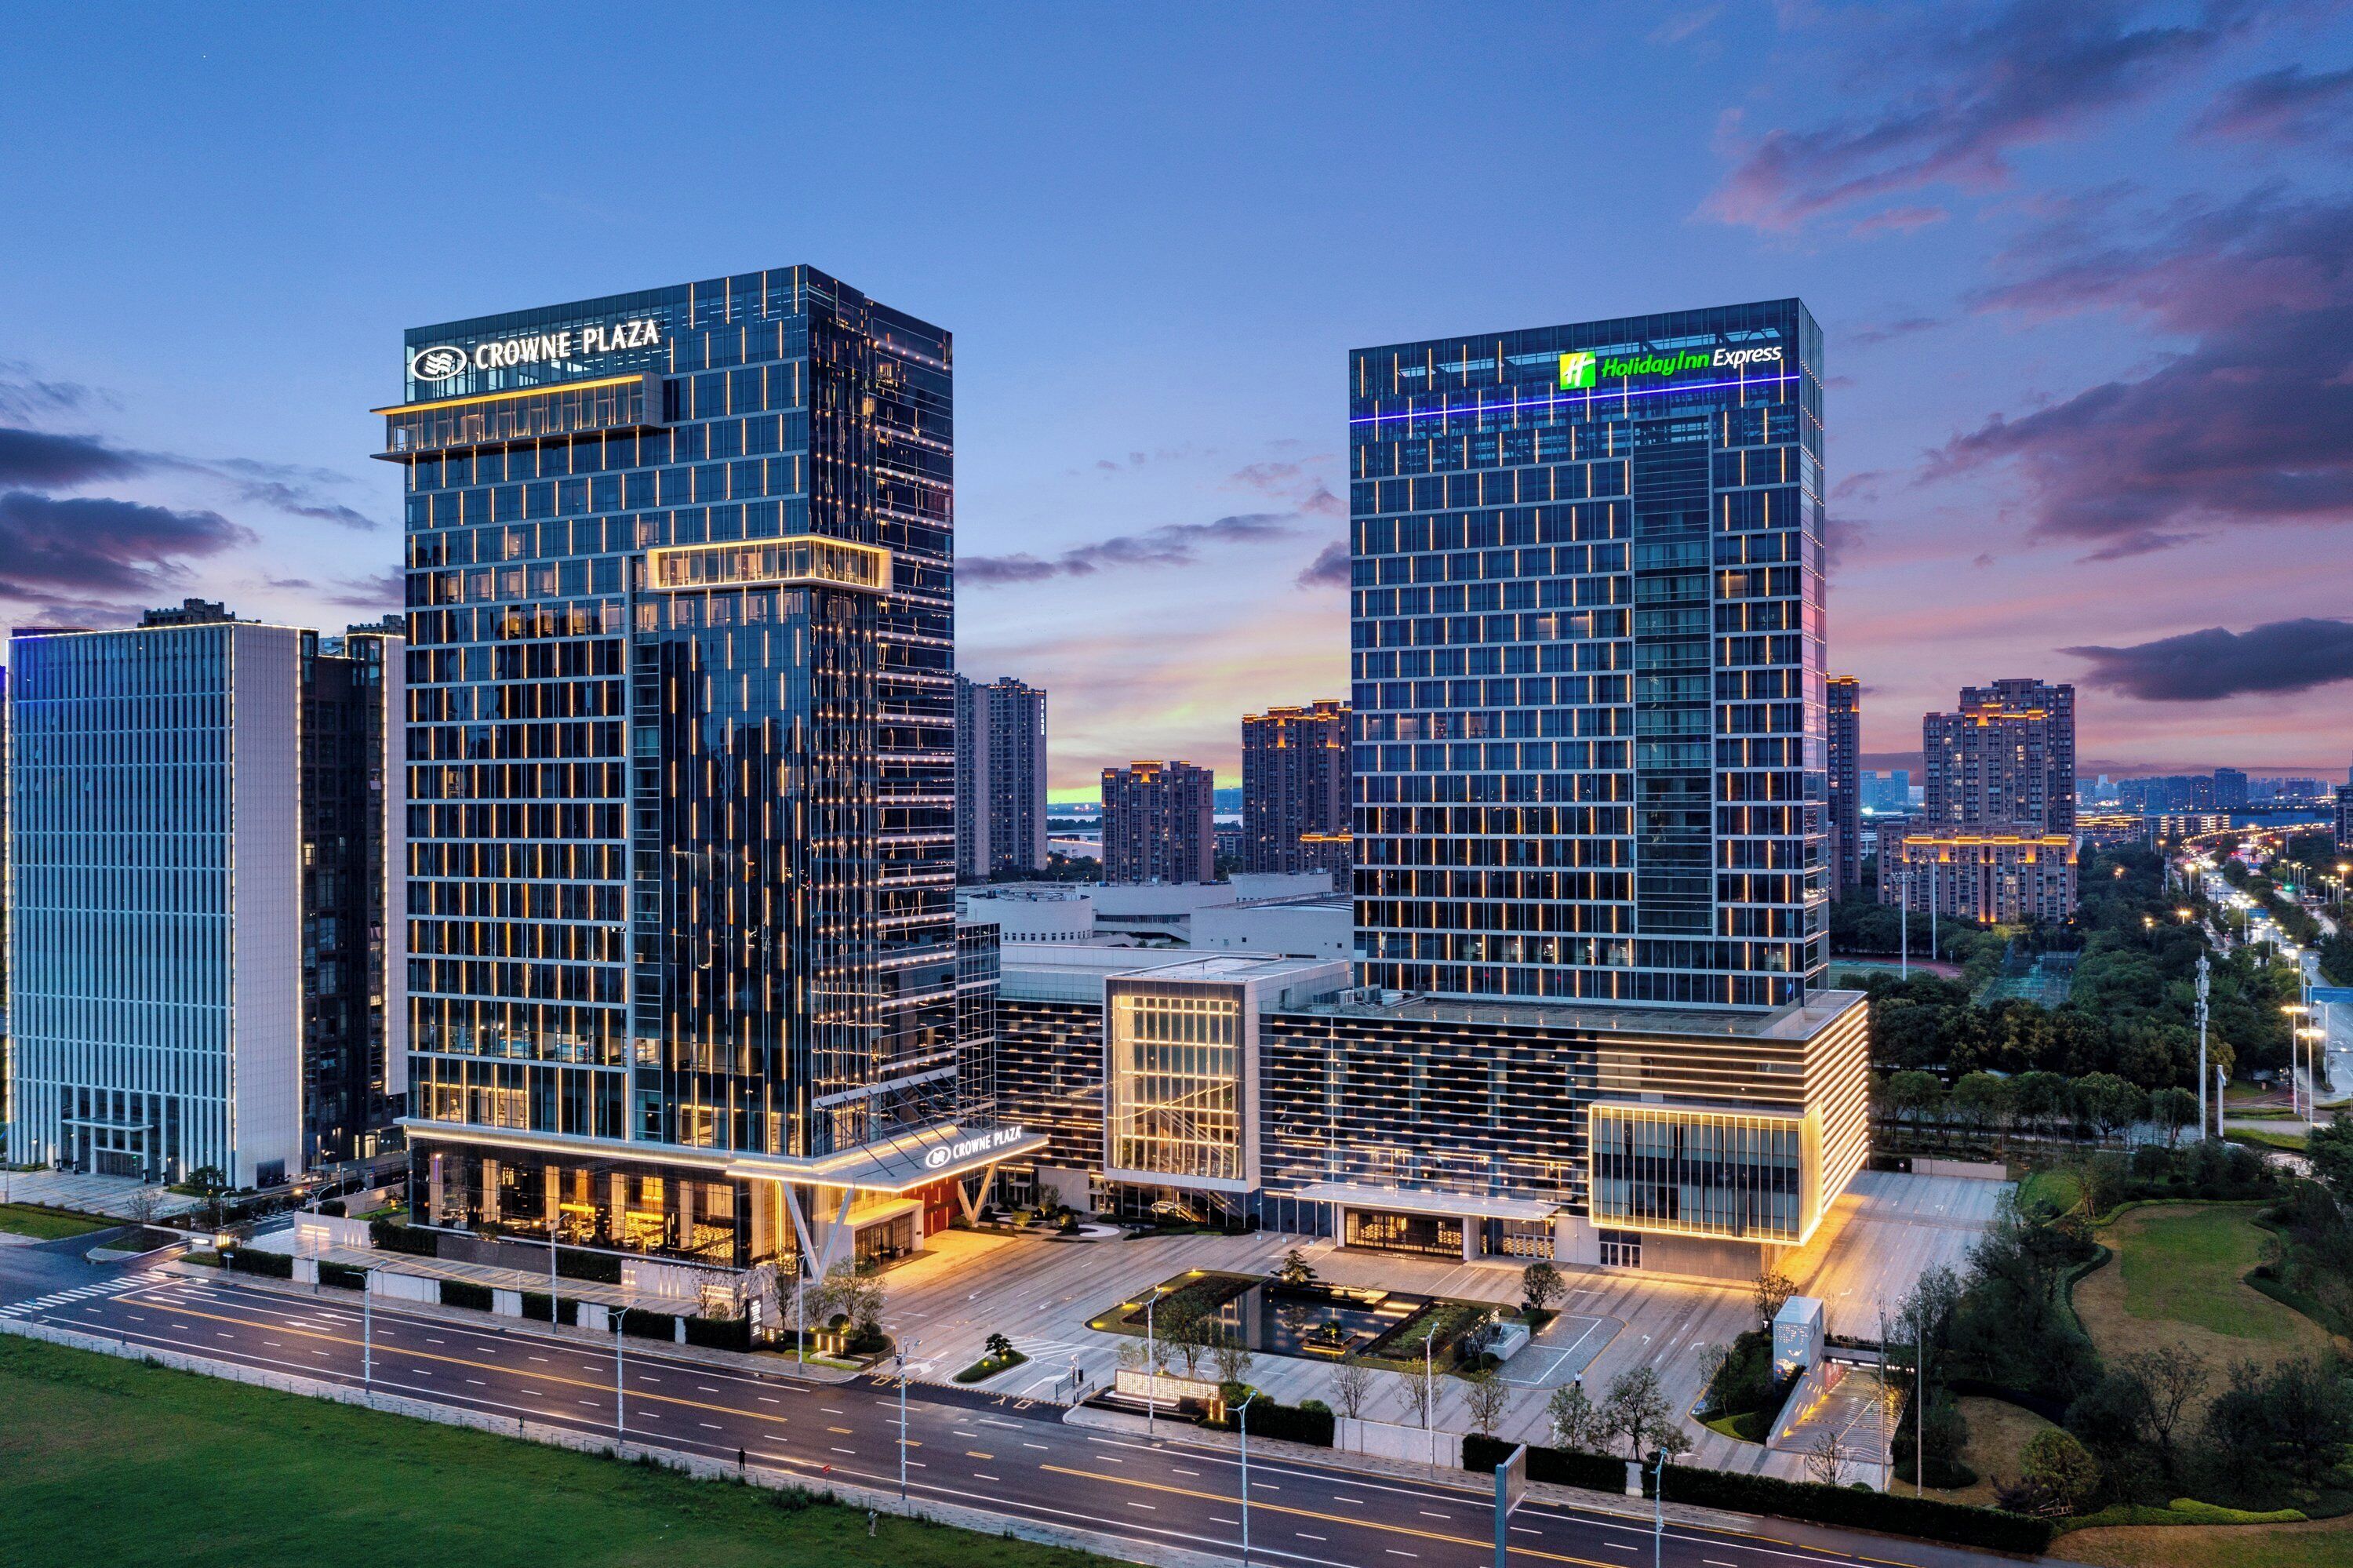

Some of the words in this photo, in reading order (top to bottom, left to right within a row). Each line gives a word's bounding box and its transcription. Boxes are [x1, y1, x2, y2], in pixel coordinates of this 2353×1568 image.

[475, 333, 570, 369] CROWNE
[583, 319, 659, 354] PLAZA
[1712, 346, 1782, 369] Express
[953, 1136, 990, 1159] CROWNE
[994, 1126, 1021, 1146] PLAZA
